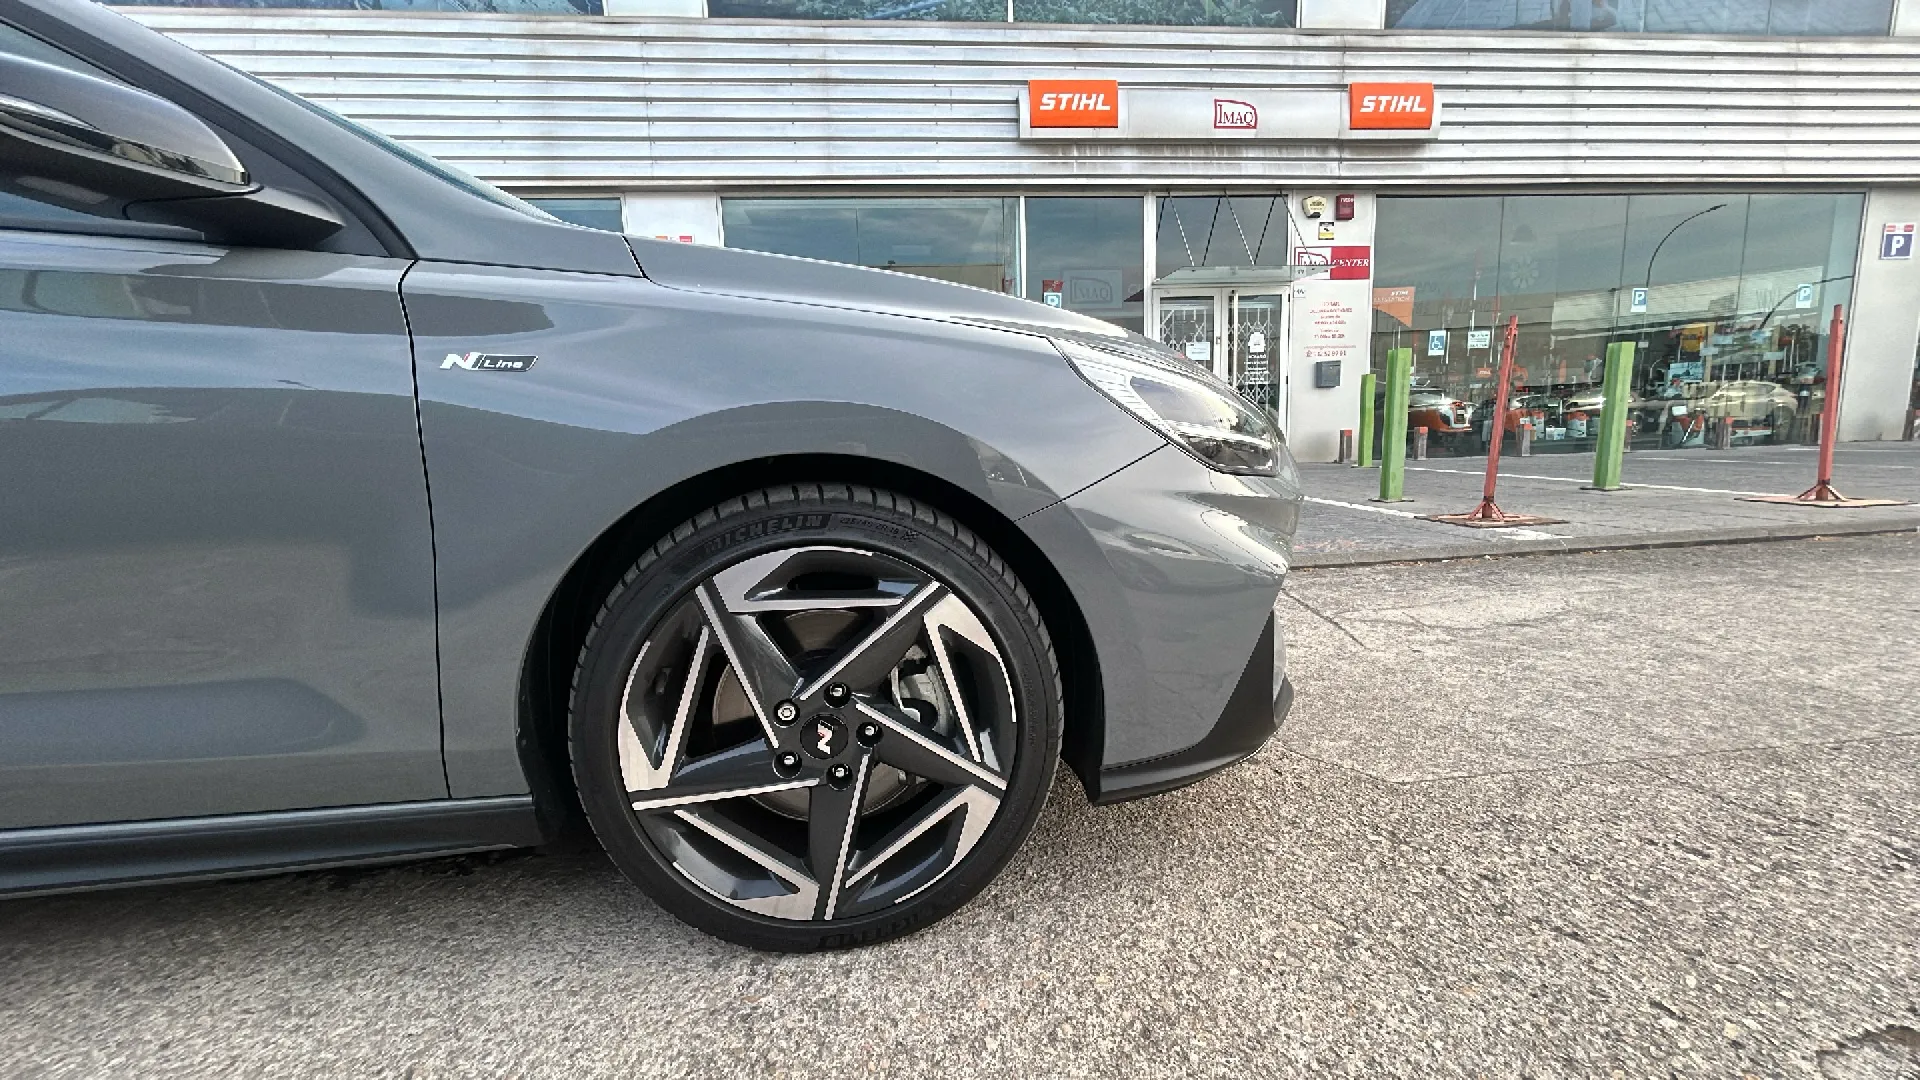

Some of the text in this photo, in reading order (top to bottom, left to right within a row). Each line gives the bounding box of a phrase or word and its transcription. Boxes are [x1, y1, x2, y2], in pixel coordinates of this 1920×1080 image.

[1040, 93, 1111, 111] STIHL
[1359, 95, 1427, 113] STIHL
[1217, 103, 1254, 127] IMAQ
[1890, 235, 1905, 256] P
[1634, 291, 1645, 305] P
[440, 352, 523, 371] N Line
[704, 515, 823, 553] MICHELIN
